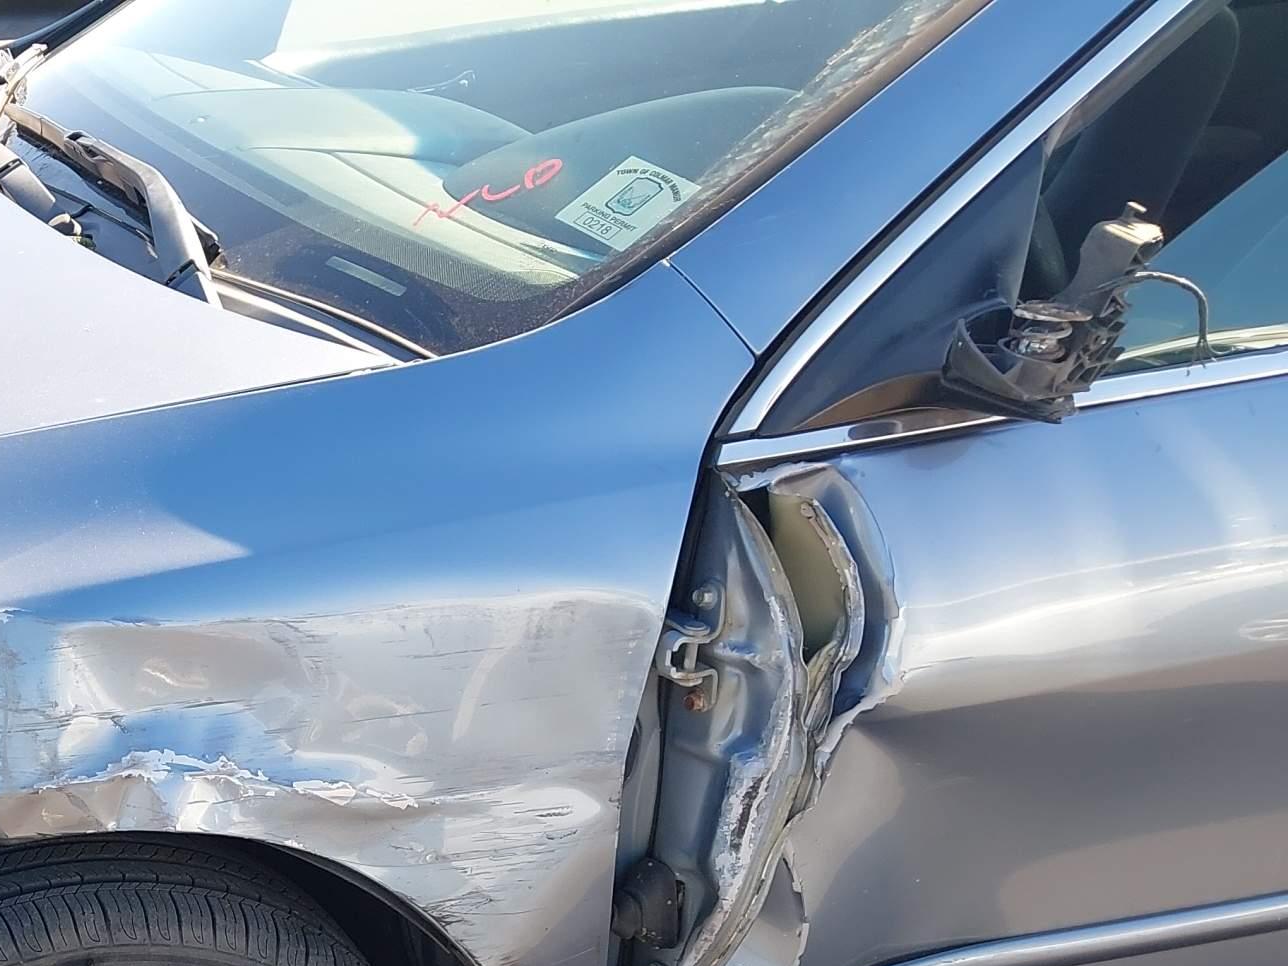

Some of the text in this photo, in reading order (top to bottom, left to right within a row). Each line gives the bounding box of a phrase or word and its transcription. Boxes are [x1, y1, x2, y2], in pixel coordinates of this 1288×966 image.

[616, 168, 639, 176] TOWN
[649, 170, 674, 185] COLMAR
[668, 183, 681, 202] MANOR
[581, 202, 637, 232] PARKING PERMIT
[582, 217, 613, 235] 0218
